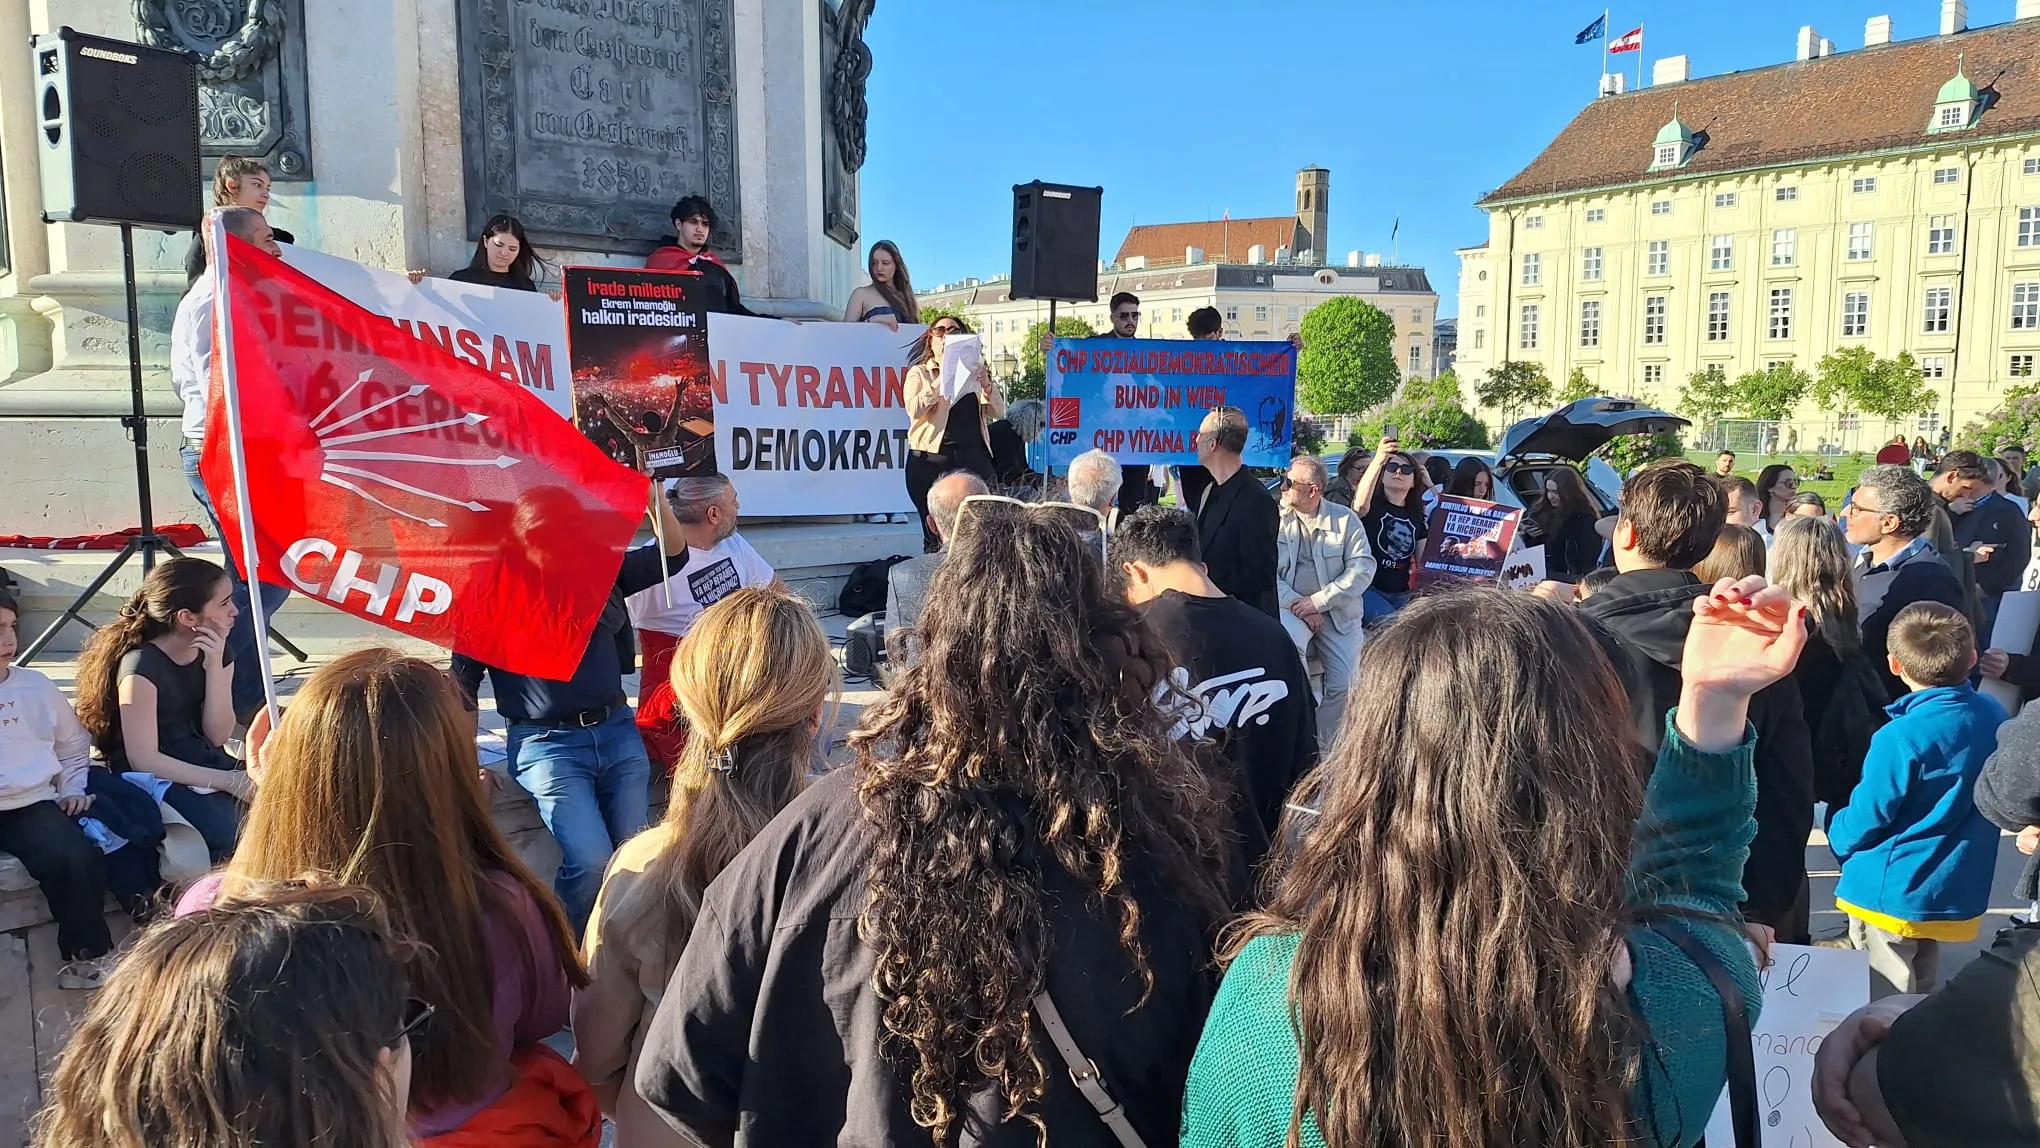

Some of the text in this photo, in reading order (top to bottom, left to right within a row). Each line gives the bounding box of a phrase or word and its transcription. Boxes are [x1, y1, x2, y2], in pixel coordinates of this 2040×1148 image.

[80, 46, 138, 65] SOUNDBOKS
[570, 64, 649, 110] Carl
[581, 156, 660, 196] 1859.
[628, 281, 686, 301] millettir,
[601, 298, 632, 310] Ekrem
[627, 310, 697, 327] iradesidir!
[1056, 349, 1290, 376] CHP SOZIALDEMOKRATISCHER
[1115, 384, 1226, 409] BUND IN WIEN
[1050, 430, 1078, 445] CHP
[1093, 429, 1125, 453] CHP
[279, 537, 453, 624] CHP
